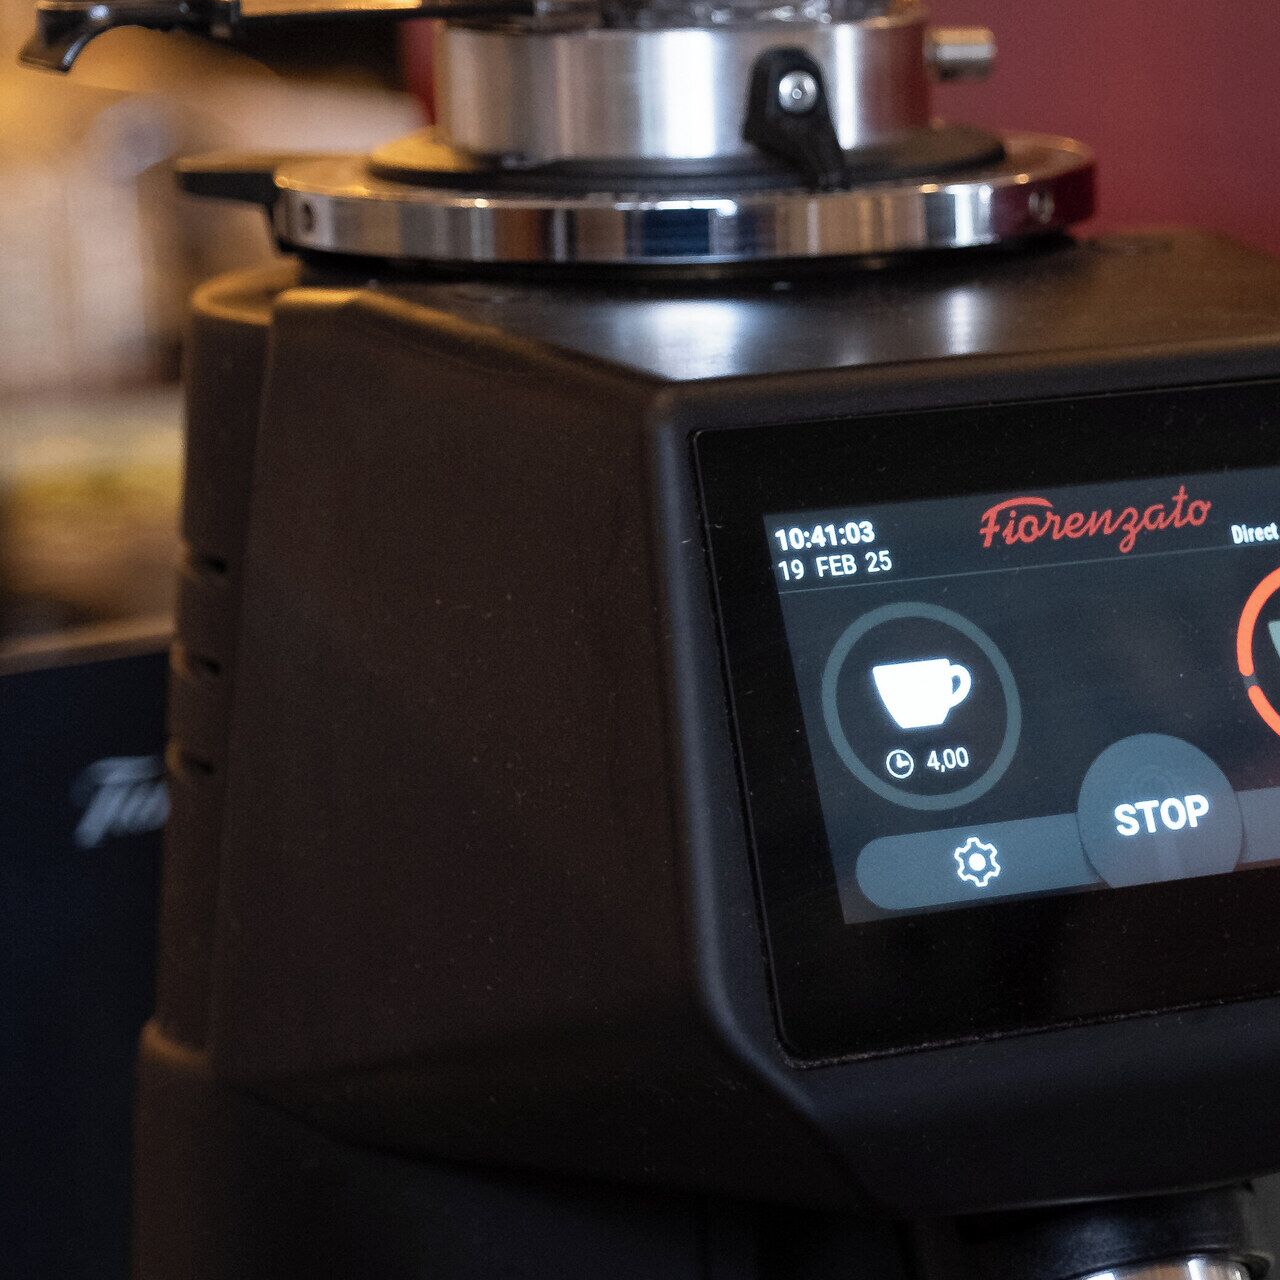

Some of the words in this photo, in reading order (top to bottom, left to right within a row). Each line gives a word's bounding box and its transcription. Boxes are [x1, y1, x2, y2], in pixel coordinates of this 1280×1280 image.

[979, 484, 1212, 554] Fiorenzato
[1230, 521, 1280, 545] Direct
[774, 520, 876, 552] 10:41:03
[778, 558, 806, 581] 19
[815, 553, 858, 578] FEB
[864, 549, 893, 573] 25
[926, 746, 970, 773] 4,00
[1113, 793, 1210, 837] STOP
